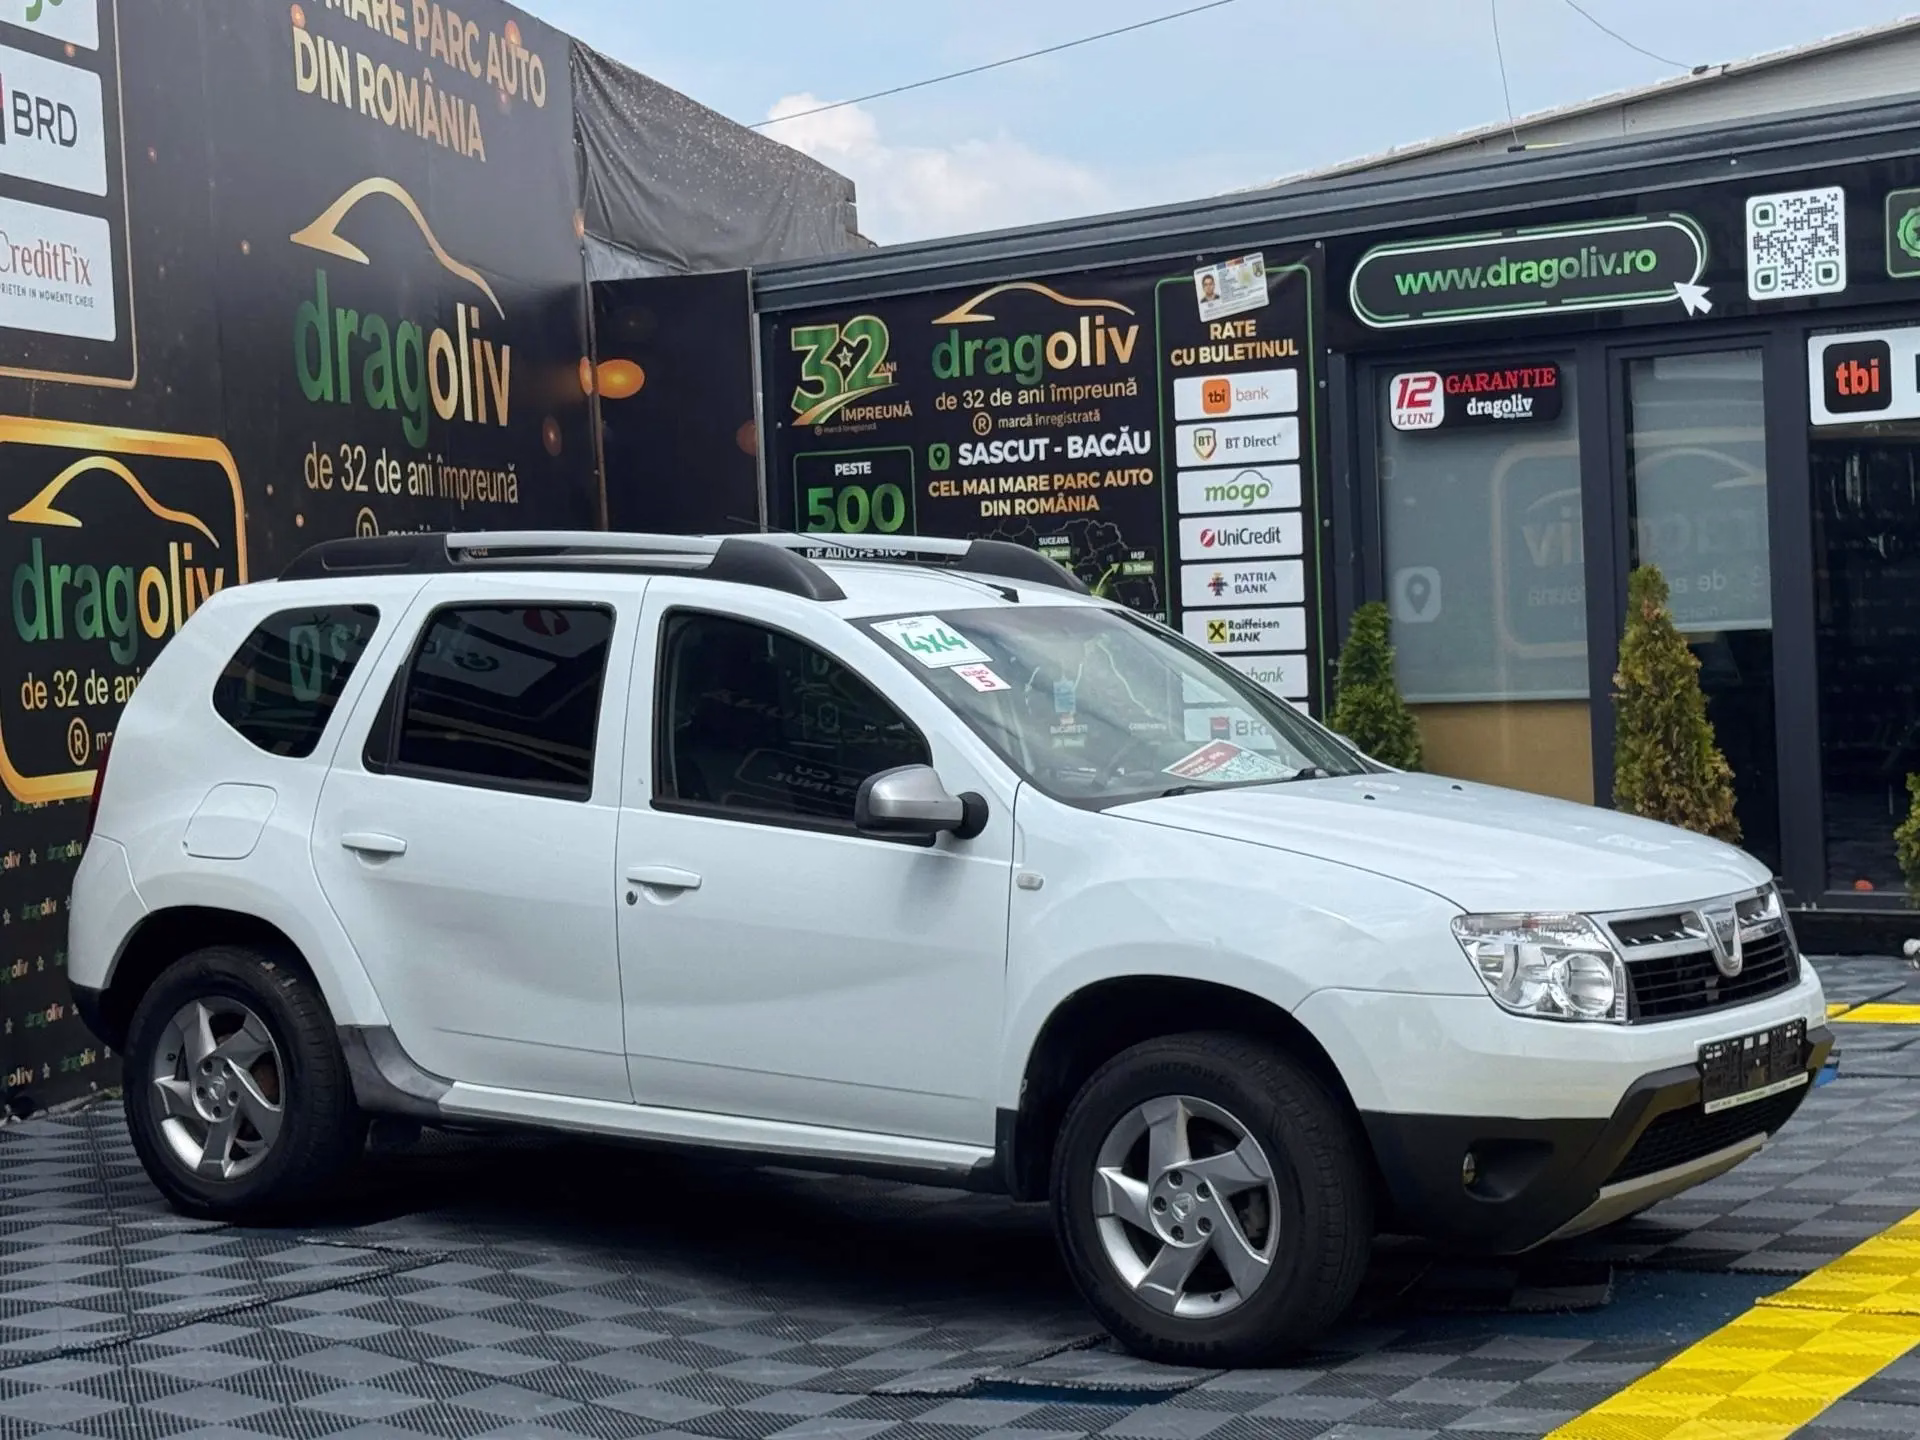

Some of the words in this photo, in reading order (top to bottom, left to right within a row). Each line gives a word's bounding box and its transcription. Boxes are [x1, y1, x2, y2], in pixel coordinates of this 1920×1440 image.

[411, 0, 481, 78] PARC
[486, 31, 546, 108] AUTO
[292, 26, 352, 109] DIN
[356, 52, 487, 163] ROMÂNIA
[12, 90, 77, 147] BRD
[1394, 246, 1657, 296] www.dragoliv.ro
[1209, 319, 1257, 340] RATE
[294, 267, 511, 449] dragoliv
[932, 314, 1139, 386] dragoliv
[1170, 348, 1195, 366] CU
[1199, 338, 1299, 364] BULETINUL
[1445, 367, 1557, 394] GARANTIE
[1836, 357, 1879, 395] tbi
[935, 391, 957, 410] de
[963, 389, 985, 408] 32
[990, 387, 1012, 406] de
[1017, 384, 1045, 404] ani
[1050, 377, 1138, 404] împreună
[1207, 389, 1226, 404] tbi
[1235, 387, 1269, 402] bank
[1396, 375, 1437, 409] 12
[841, 400, 913, 422] ÎMPREUNĂ
[1397, 412, 1434, 425] LUNI
[1466, 393, 1533, 418] dragoliv
[998, 414, 1033, 428] marcă
[958, 437, 1050, 466] SASCUT
[1067, 426, 1152, 459] BACĂU
[1198, 435, 1212, 447] BT
[1225, 437, 1240, 449] BT
[304, 441, 333, 490] de
[340, 443, 368, 492] 32
[375, 447, 401, 494] de
[407, 452, 433, 496] ani
[437, 454, 519, 510] împreună
[834, 461, 872, 476] PESTE
[928, 481, 960, 497] CEL
[962, 478, 995, 496] MAI
[999, 474, 1051, 493] MARE
[1053, 471, 1100, 490] PARC
[1103, 468, 1153, 487] AUTO
[1205, 483, 1271, 508] mogo
[807, 483, 906, 533] 500
[980, 500, 1011, 517] DIN
[1014, 492, 1100, 515] ROMÂNIA
[1217, 526, 1282, 546] UniCredit
[1234, 571, 1277, 582] PATRIA
[1235, 583, 1268, 594] BANK
[1228, 618, 1280, 631] Raiffeisen
[1229, 632, 1260, 642] BANK
[21, 672, 48, 710] de
[54, 670, 79, 708] 32
[85, 668, 109, 705] de
